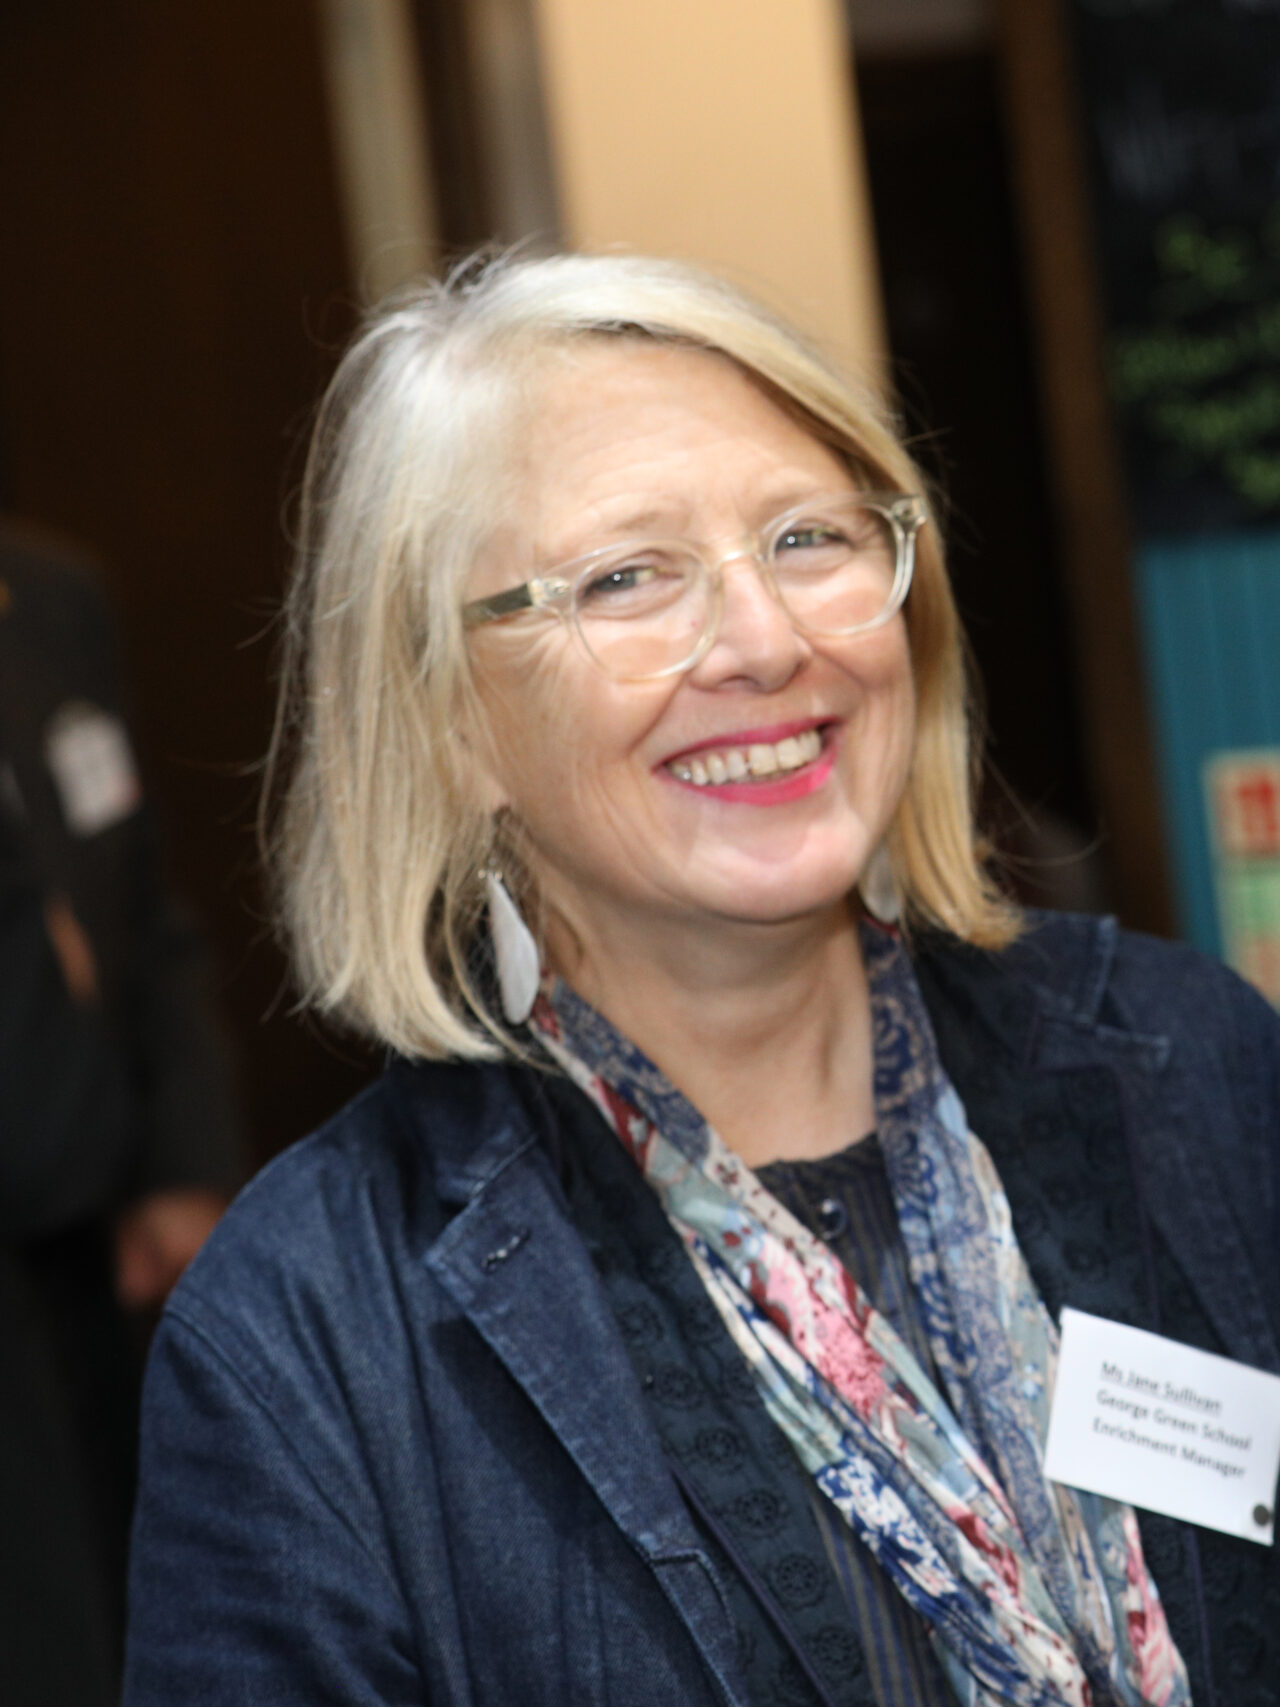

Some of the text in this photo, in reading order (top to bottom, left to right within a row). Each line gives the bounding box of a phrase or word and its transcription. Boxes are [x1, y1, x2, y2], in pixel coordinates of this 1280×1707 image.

[1096, 1389, 1252, 1450] George Green School
[1128, 1371, 1160, 1392] Jane
[1164, 1380, 1222, 1411] Sullivan
[1092, 1417, 1246, 1478] Enrichment Manager
